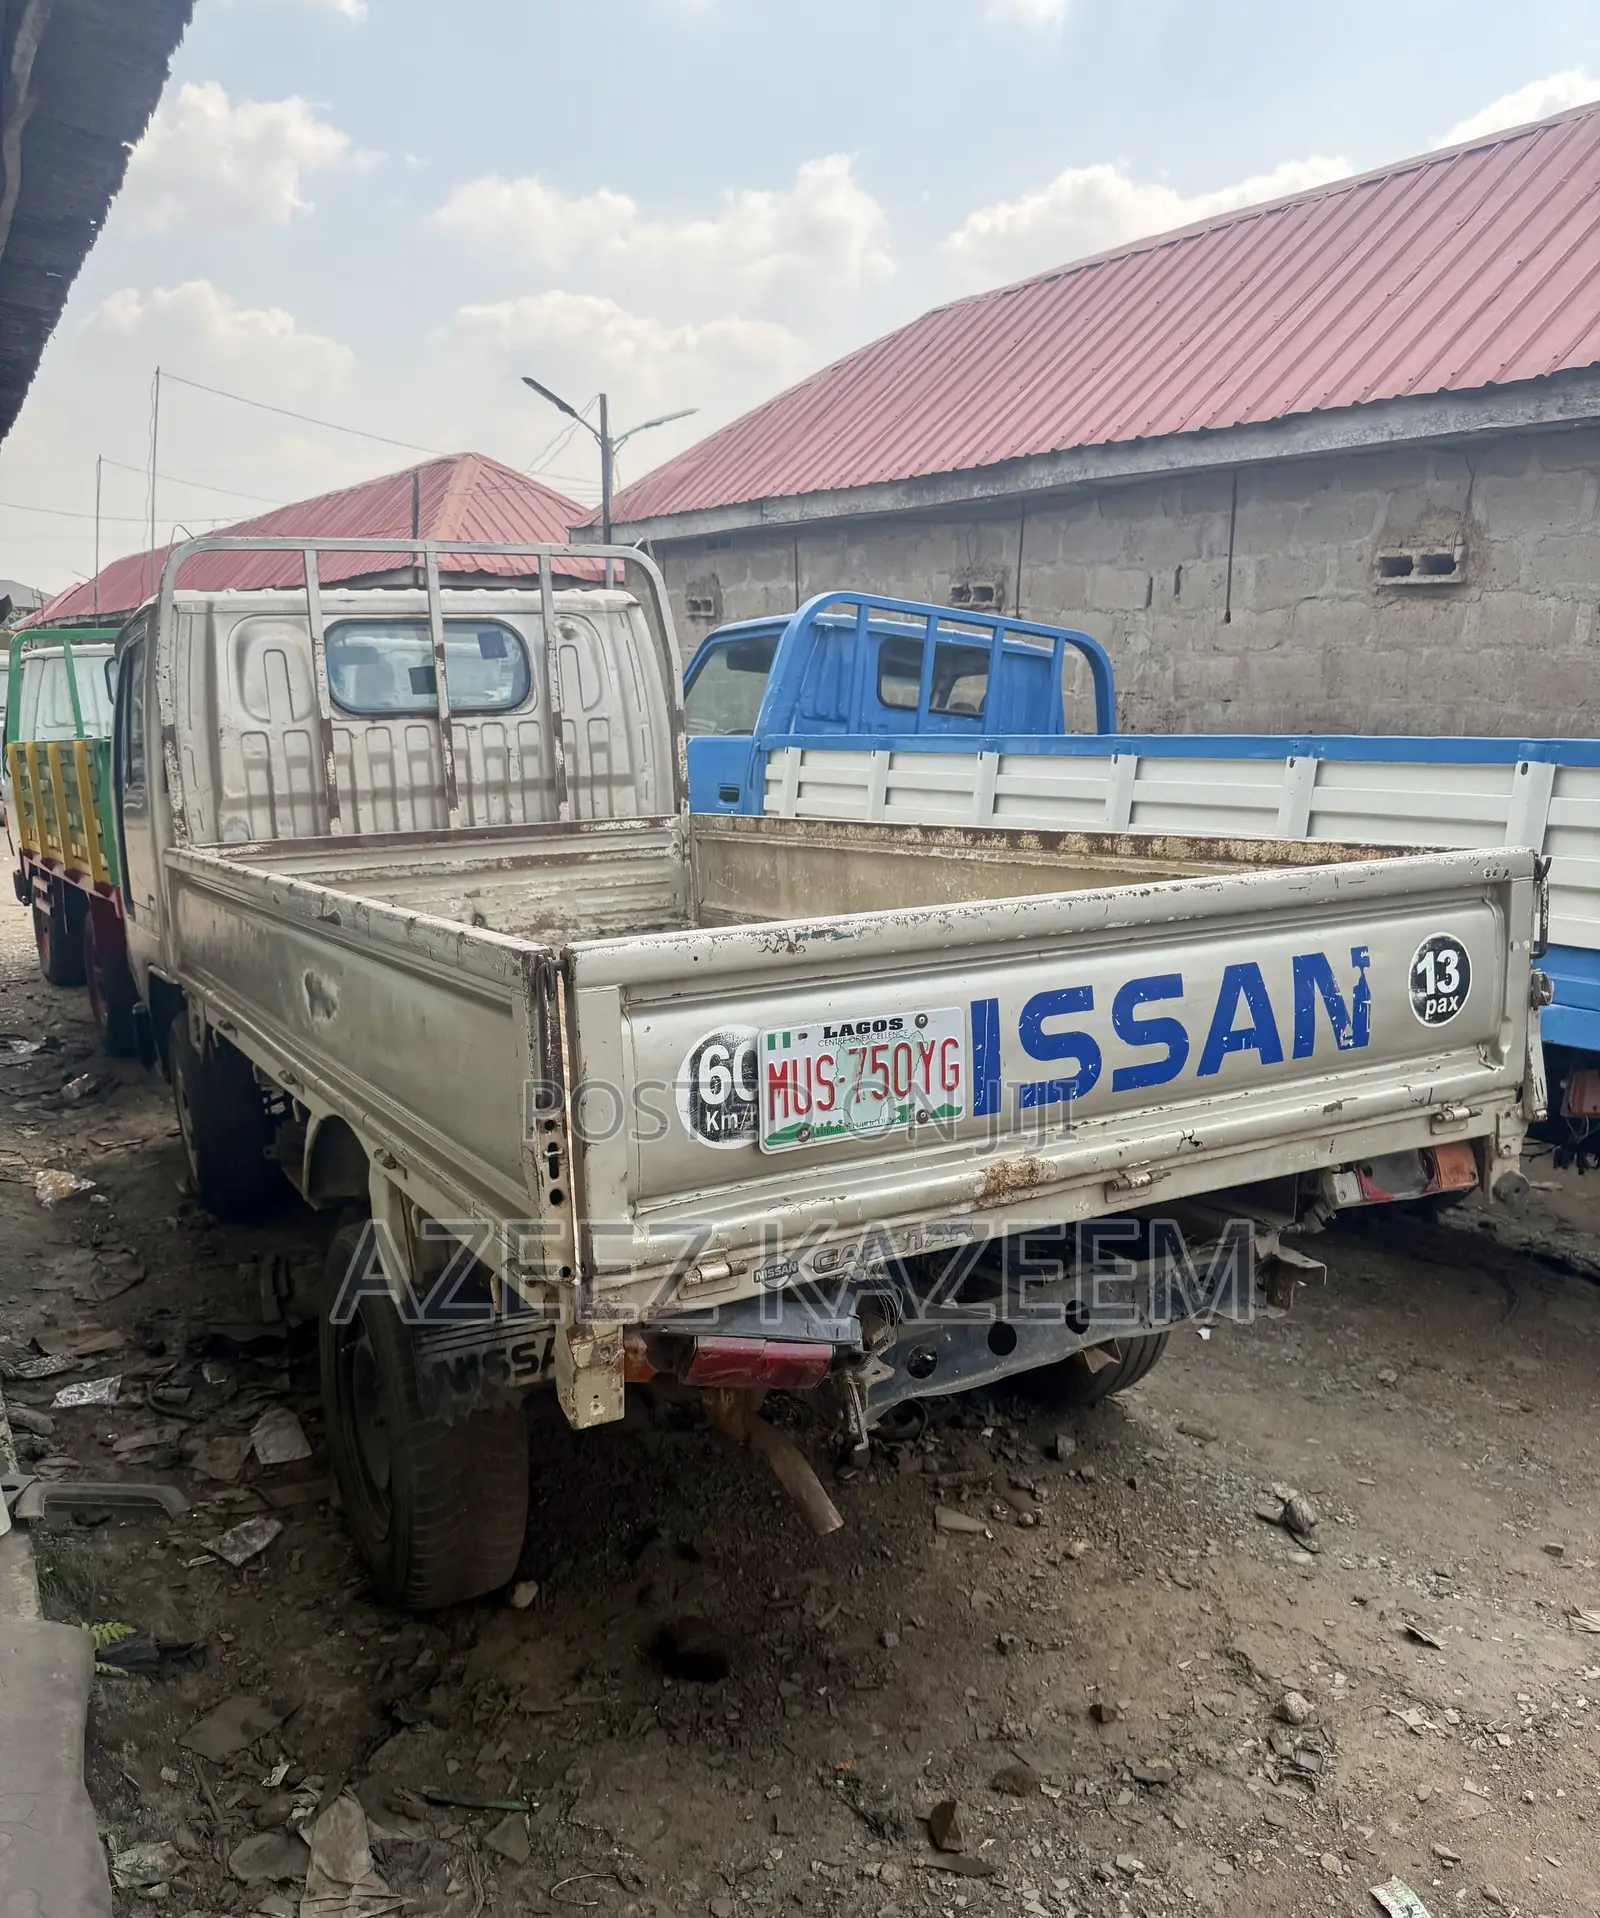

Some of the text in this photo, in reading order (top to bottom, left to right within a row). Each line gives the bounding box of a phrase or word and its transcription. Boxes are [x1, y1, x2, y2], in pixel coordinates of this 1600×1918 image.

[1416, 949, 1460, 996] 13
[1424, 995, 1459, 1021] pax
[817, 1028, 909, 1048] CENTRE OF EXCELLENCE
[823, 1017, 904, 1040] LAGOS
[971, 945, 1371, 1118] ISSAN
[754, 1260, 800, 1284] NISSAN
